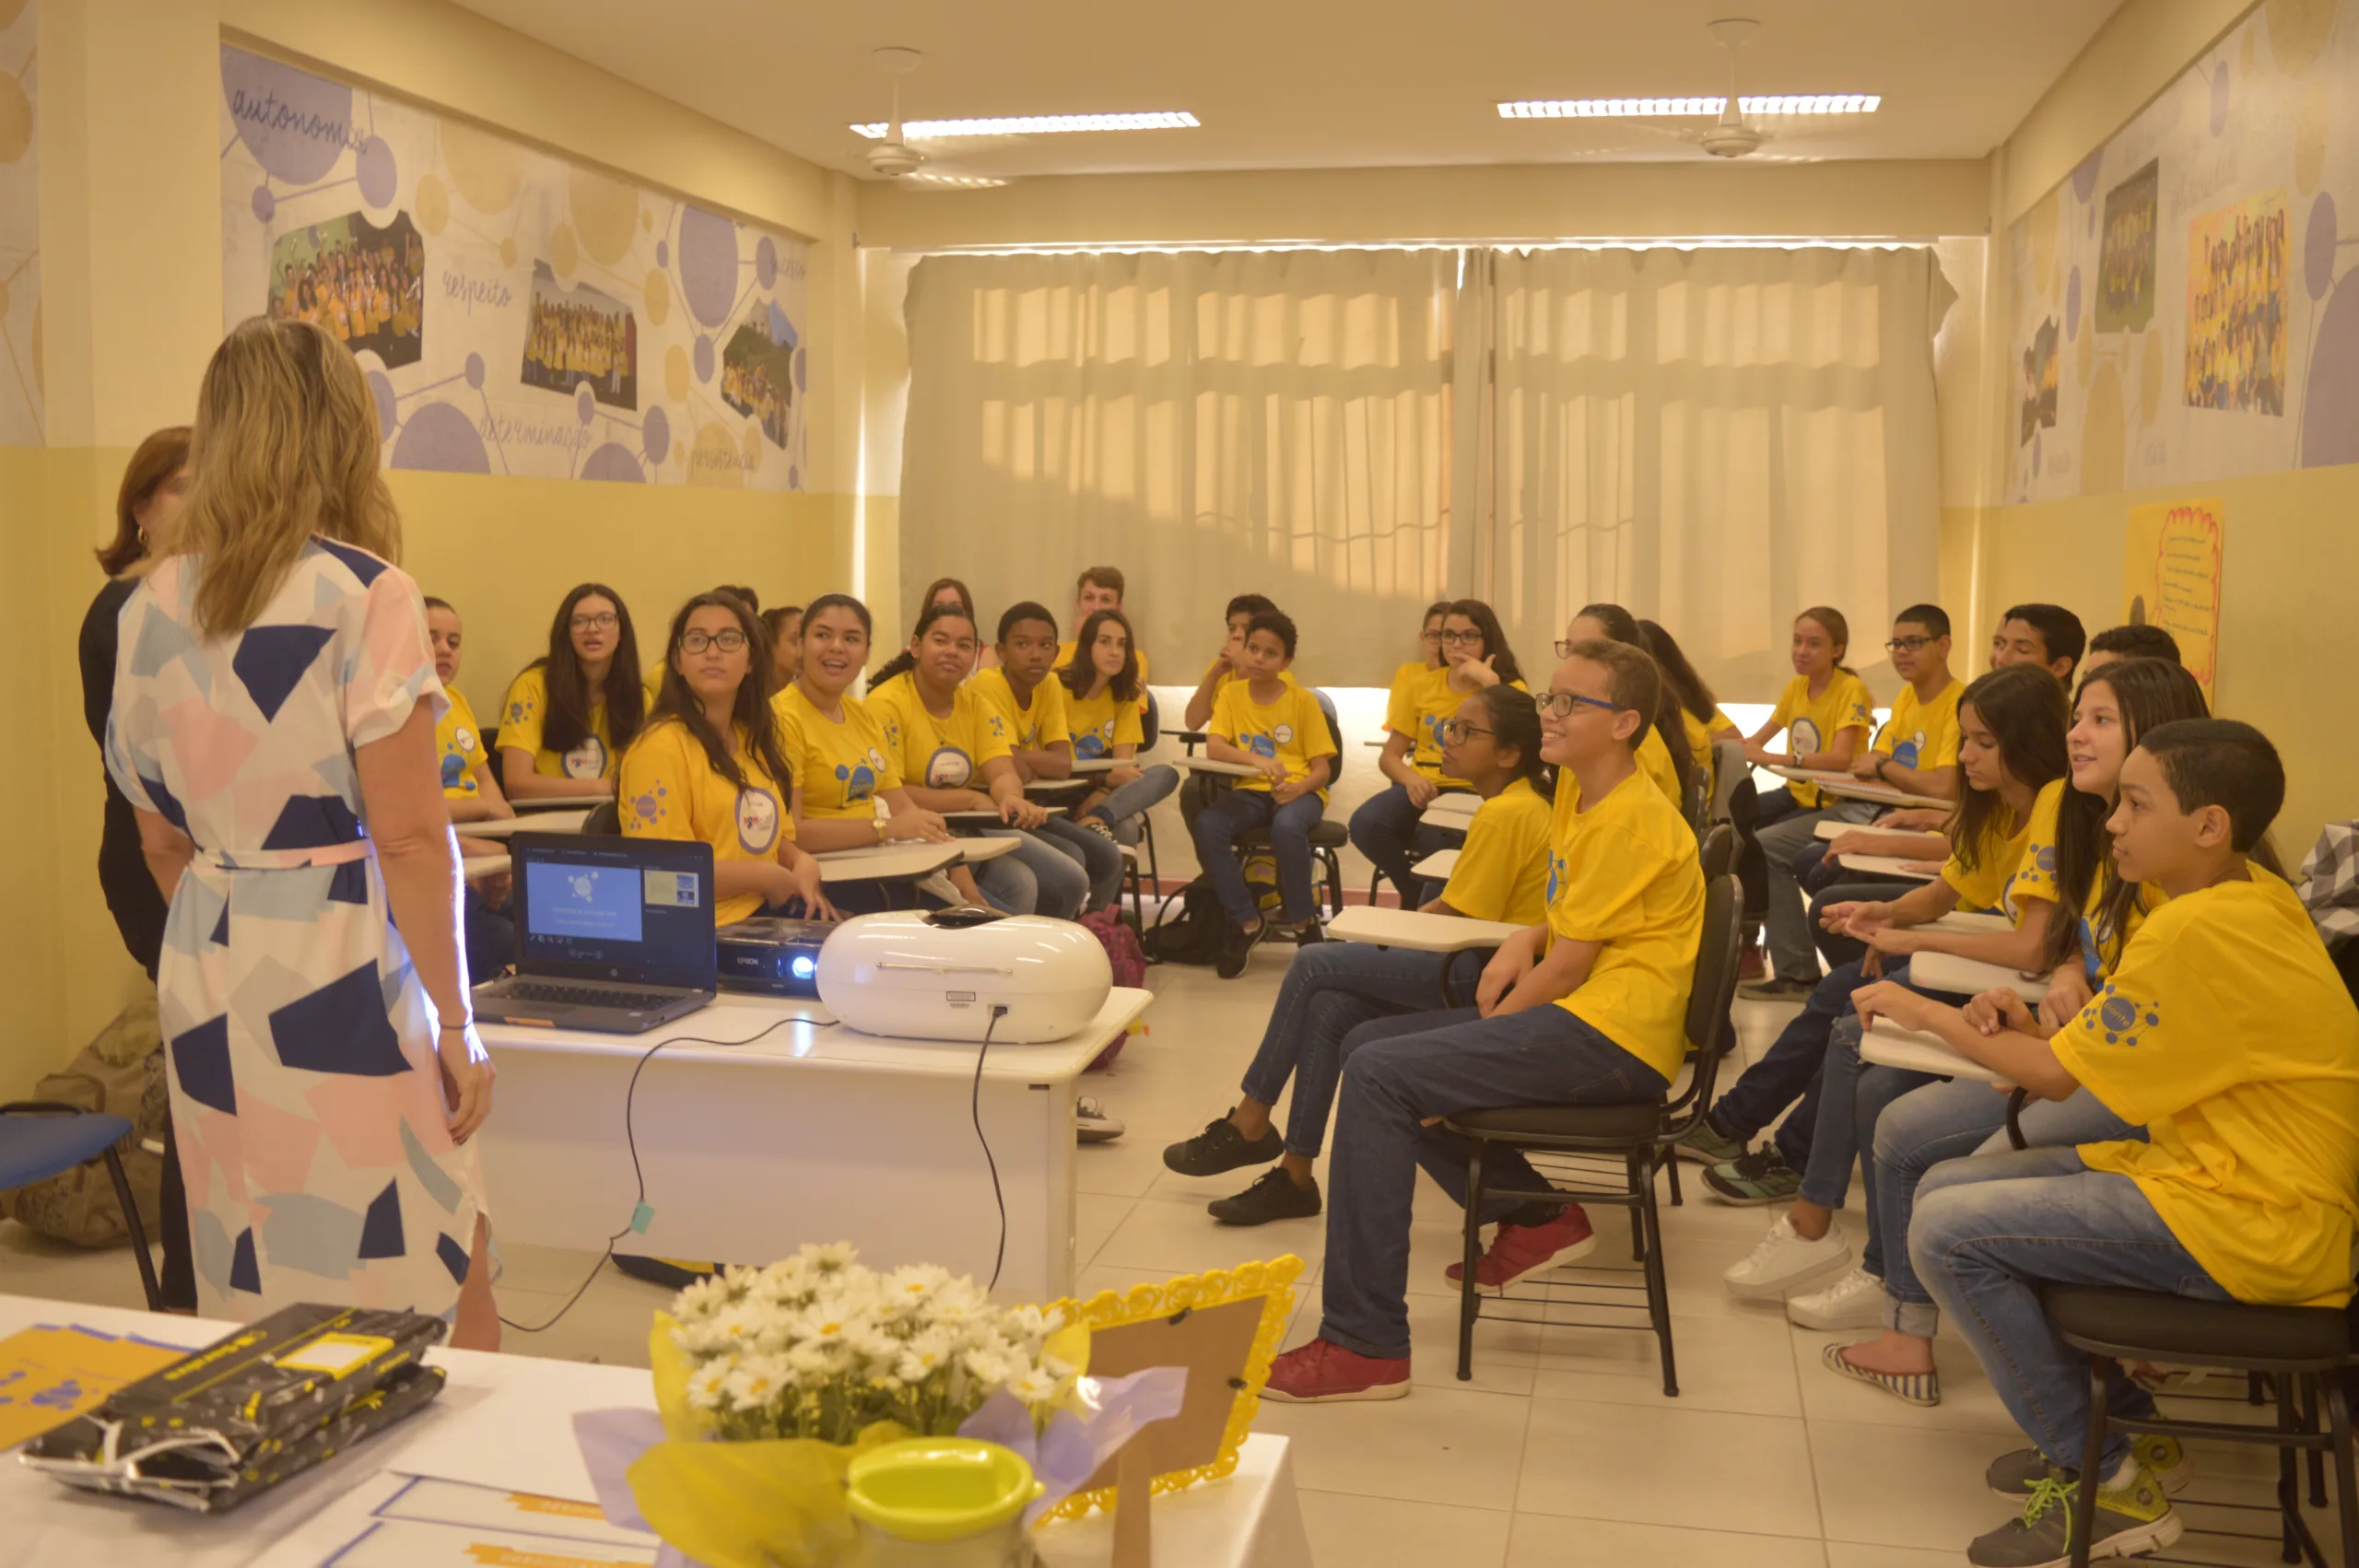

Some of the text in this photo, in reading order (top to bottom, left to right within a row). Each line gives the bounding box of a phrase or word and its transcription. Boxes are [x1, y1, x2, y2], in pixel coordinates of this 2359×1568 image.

[233, 88, 369, 156] autonomia
[442, 270, 512, 317] respeito
[2104, 1002, 2130, 1027] ponte
